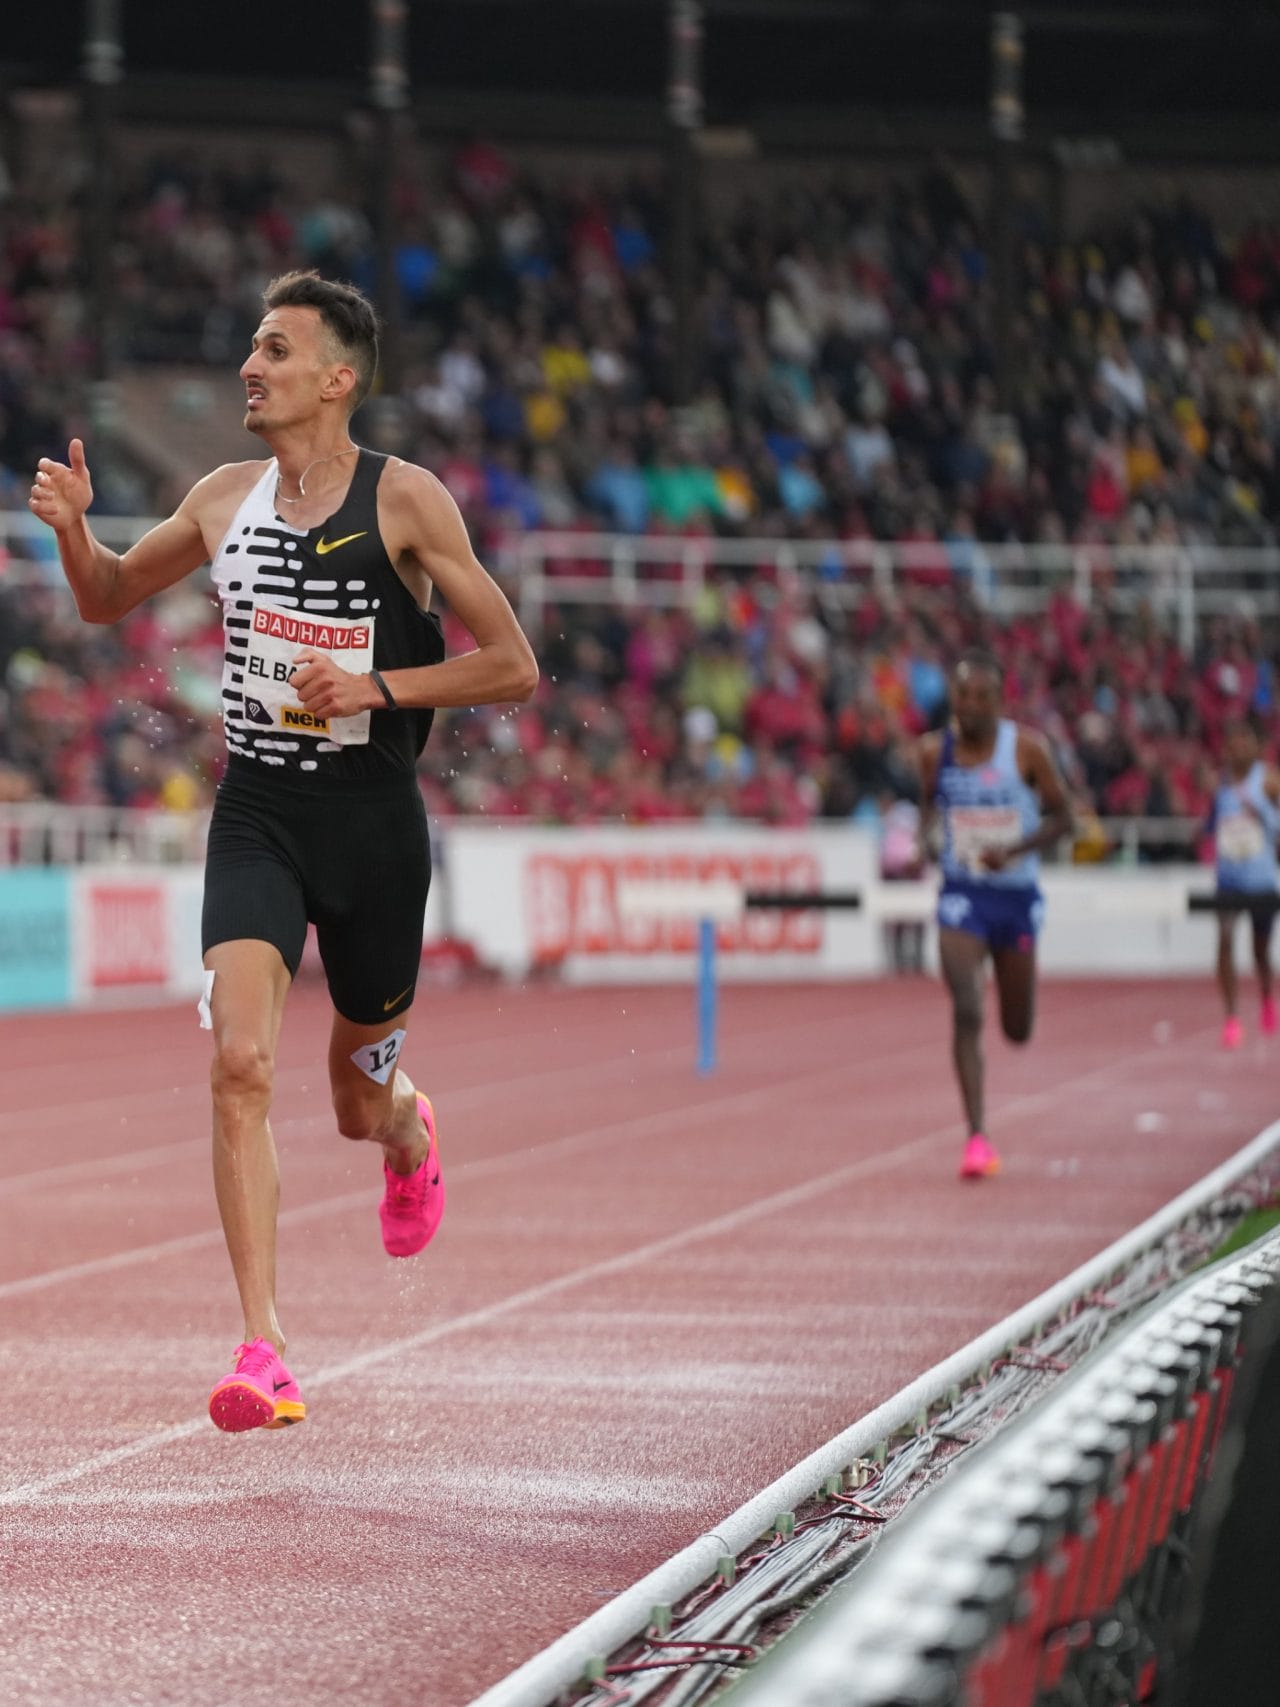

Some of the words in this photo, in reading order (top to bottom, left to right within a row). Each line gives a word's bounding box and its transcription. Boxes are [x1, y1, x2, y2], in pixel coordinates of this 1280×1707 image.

[255, 612, 368, 647] BAUHAUS
[248, 655, 269, 678] EL
[369, 1039, 397, 1073] 12
